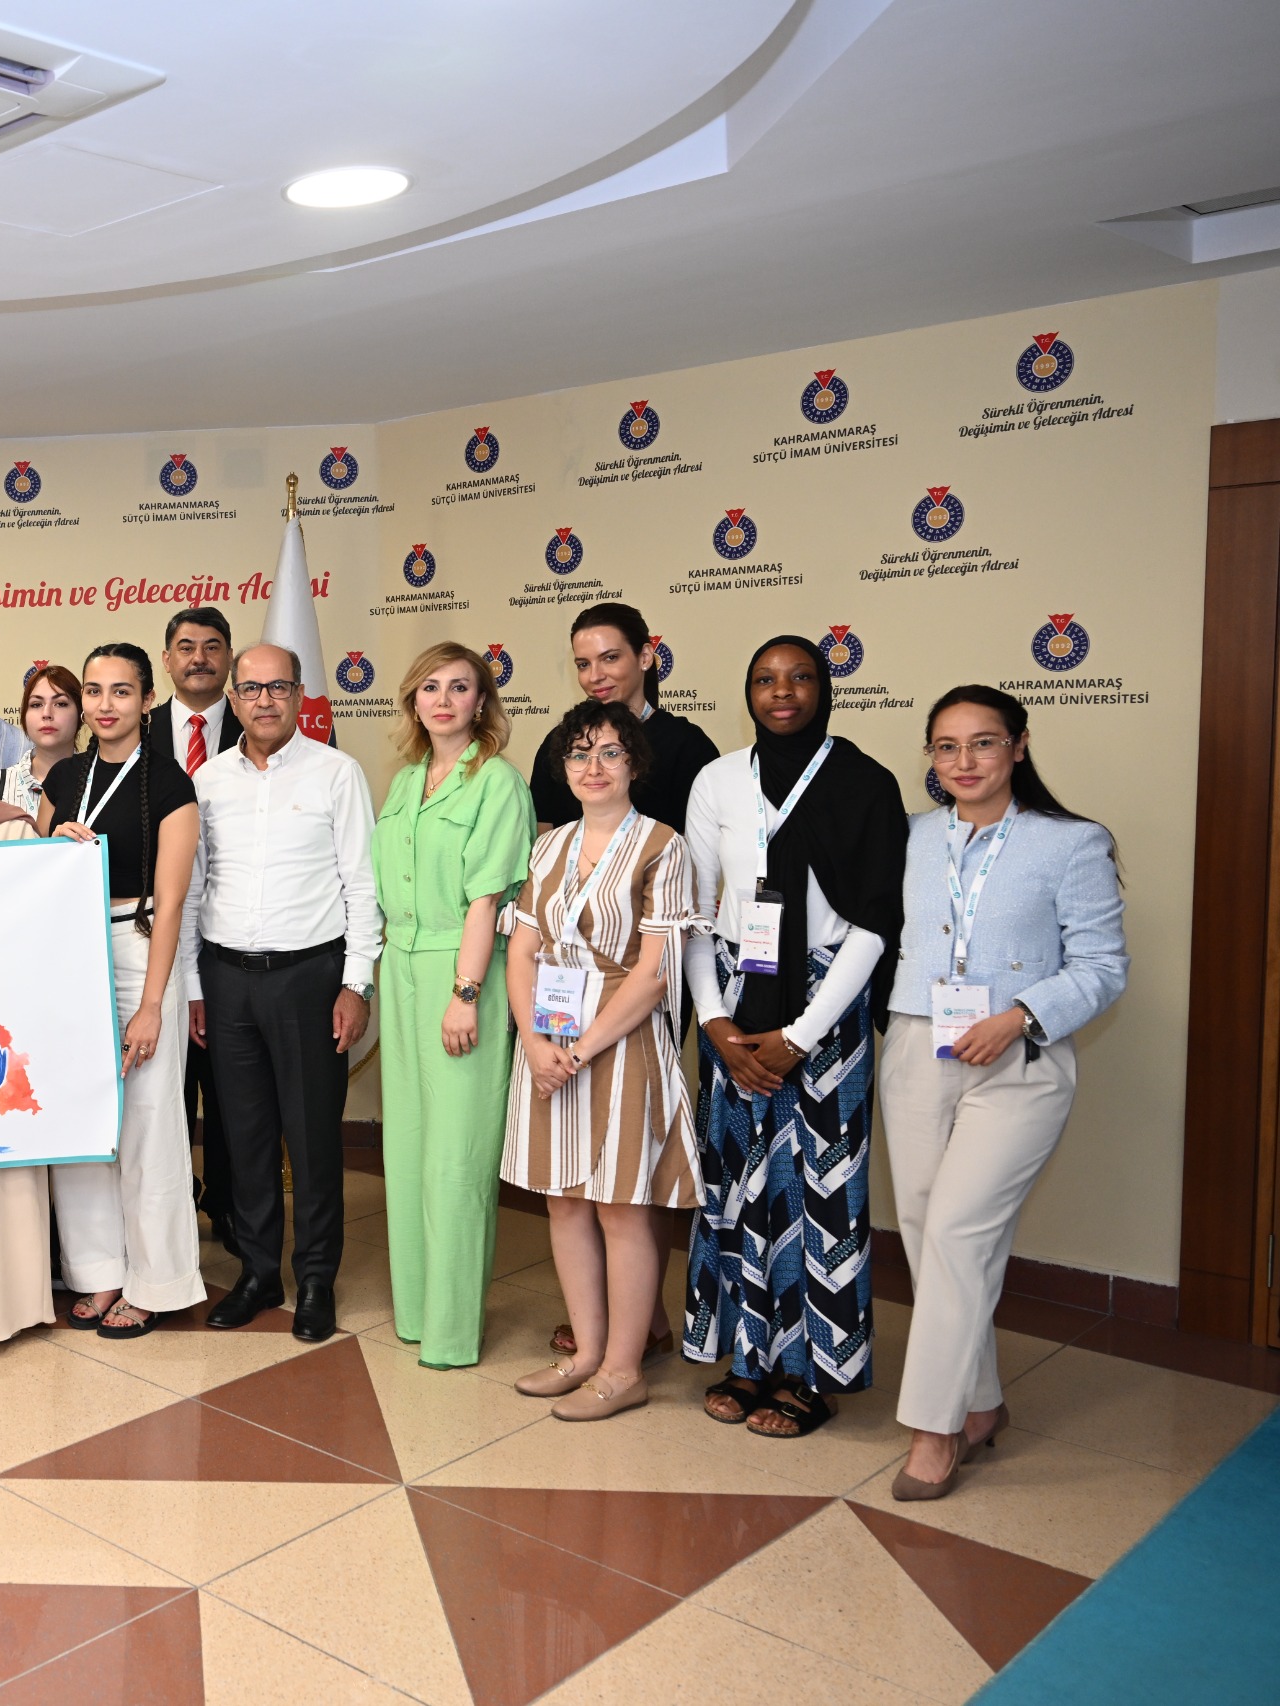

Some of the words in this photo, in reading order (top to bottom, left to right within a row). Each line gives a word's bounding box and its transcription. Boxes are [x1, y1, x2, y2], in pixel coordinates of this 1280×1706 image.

[982, 404, 1025, 419] Sürekli
[1027, 394, 1104, 415] Öğrenmenin,
[959, 421, 1015, 439] Değişimin
[1018, 421, 1030, 430] ve
[1034, 411, 1089, 430] Geleceğin
[1092, 404, 1134, 421] Adresi
[774, 424, 876, 446] KAHRAMANMARAŞ
[754, 449, 787, 463] SÜTÇÜ
[790, 447, 820, 458] İMAM
[824, 434, 898, 454] ÜNİVERSİTESİ
[595, 459, 625, 472] Sürekli
[627, 452, 682, 469] Öğrenmenin,
[446, 474, 520, 491] KAHRAMANMARAŞ
[578, 474, 619, 488] Değişimin
[632, 467, 671, 482] Geleceğin
[673, 462, 703, 475] Adresi
[297, 497, 327, 506] Sürekli
[328, 494, 379, 507] Öğrenmenin,
[432, 494, 456, 506] SÜTÇÜ
[459, 492, 480, 502] İMAM
[483, 483, 535, 499] ÜNİVERSİTESİ
[139, 501, 220, 510] KAHRAMANMARAŞ
[322, 508, 330, 516] ve
[332, 505, 369, 516] Geleceğin
[372, 503, 395, 514] Adresi
[17, 519, 52, 529] Geleceğin
[54, 518, 80, 527] Adresi
[123, 514, 150, 524] SÜTÇÜ
[153, 513, 177, 521] İMAM
[180, 510, 236, 520] ÜNİVERSİTESİ
[881, 552, 919, 564] Sürekli
[922, 547, 992, 564] Öğrenmenin,
[689, 563, 782, 578] KAHRAMANMARAŞ
[860, 568, 911, 582] Değişimin
[928, 562, 978, 578] Geleceğin
[981, 559, 1019, 573] Adresi
[524, 582, 551, 593] Sürekli
[553, 579, 603, 593] Öğrenmenin,
[670, 582, 700, 595] SÜTÇÜ
[704, 581, 731, 591] İMAM
[735, 574, 803, 589] ÜNİVERSİTESİ
[70, 587, 97, 606] ve
[105, 576, 230, 611] Geleceğin
[386, 591, 455, 603] KAHRAMANMARAŞ
[509, 596, 546, 608] Değişimin
[558, 592, 593, 604] Geleceğin
[596, 589, 622, 600] Adresi
[370, 606, 395, 617] SÜTÇÜ
[397, 606, 418, 614] İMAM
[420, 600, 469, 612] ÜNİVERSİTESİ
[832, 684, 889, 698] ğrenmenin,
[1000, 678, 1122, 690] KAHRAMANMARAŞ
[879, 698, 915, 709] Adresi
[1059, 691, 1149, 704] ÜNİVERSİTESİ
[525, 705, 550, 715] Adresi
[660, 701, 716, 711] NİVERSİTESİ
[299, 714, 328, 729] T.C.
